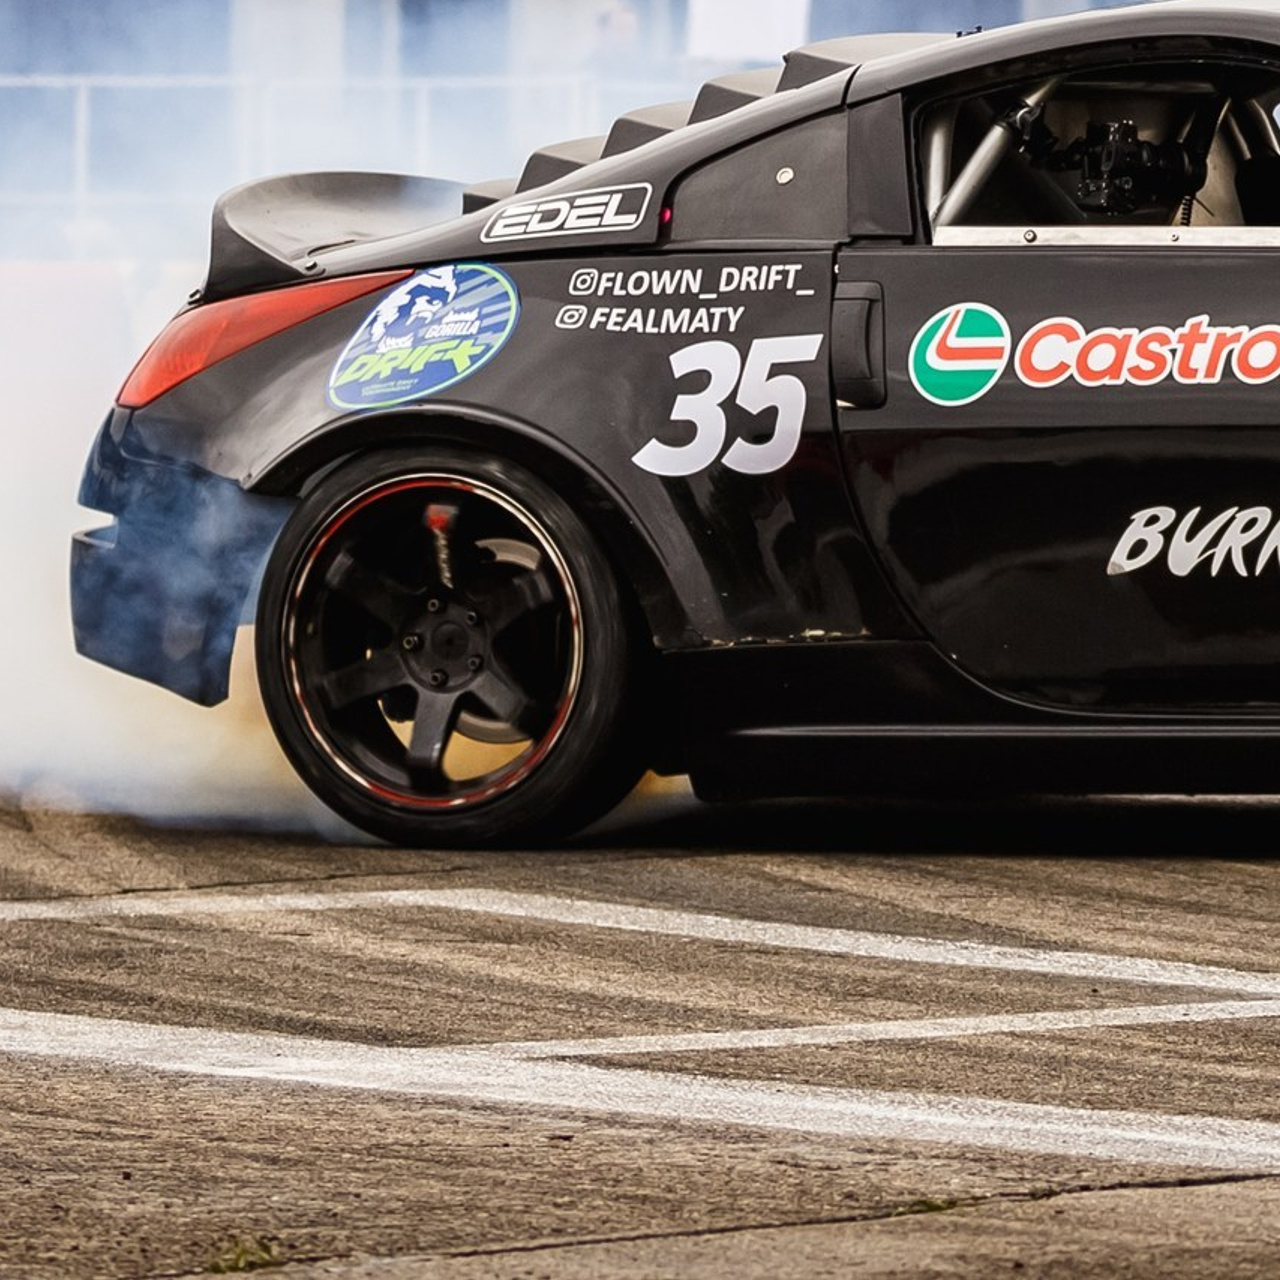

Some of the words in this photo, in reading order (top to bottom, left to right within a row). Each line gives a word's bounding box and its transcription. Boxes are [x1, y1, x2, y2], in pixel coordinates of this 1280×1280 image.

[489, 193, 638, 238] EDEL
[597, 264, 815, 300] FLOWN_DRIFT_
[424, 319, 482, 340] GORILLA
[588, 306, 746, 334] FEALMATY
[333, 339, 486, 387] DRIFT
[632, 334, 824, 477] 35
